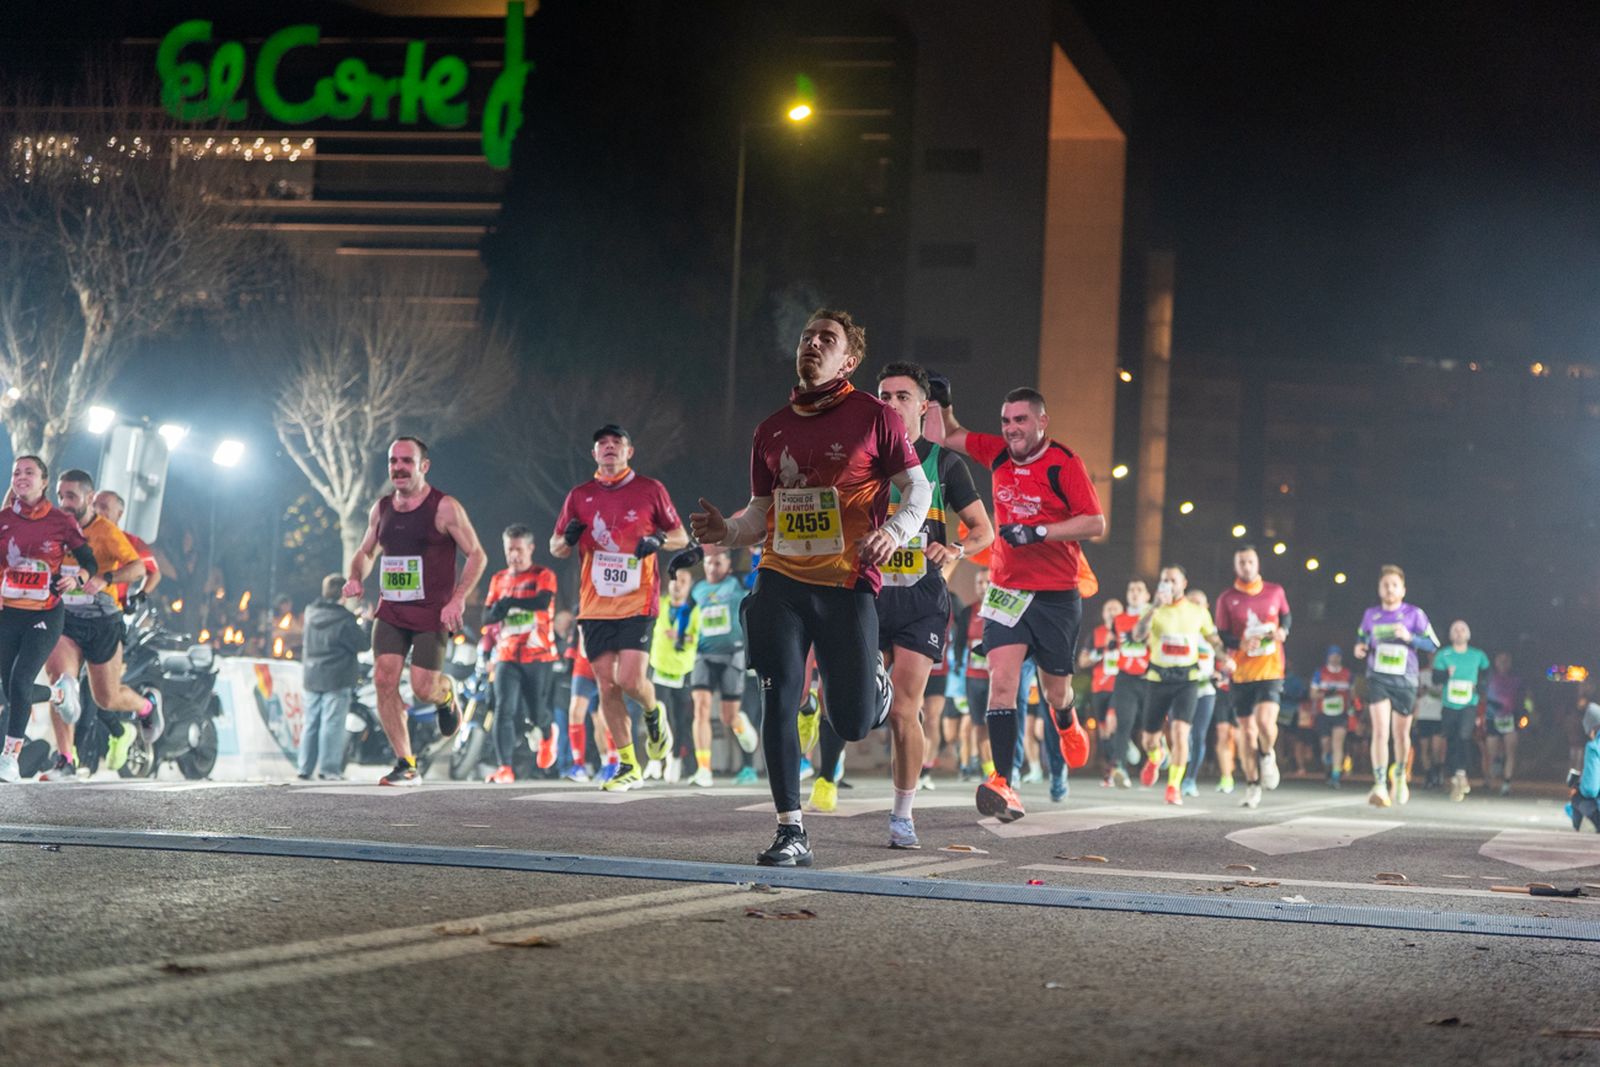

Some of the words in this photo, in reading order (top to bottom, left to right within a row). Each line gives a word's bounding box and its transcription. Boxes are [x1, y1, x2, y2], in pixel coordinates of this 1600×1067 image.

[156, 19, 248, 122] El
[255, 24, 468, 127] Corte
[786, 511, 830, 533] 2455
[603, 568, 628, 583] 930
[989, 588, 1019, 610] 9267
